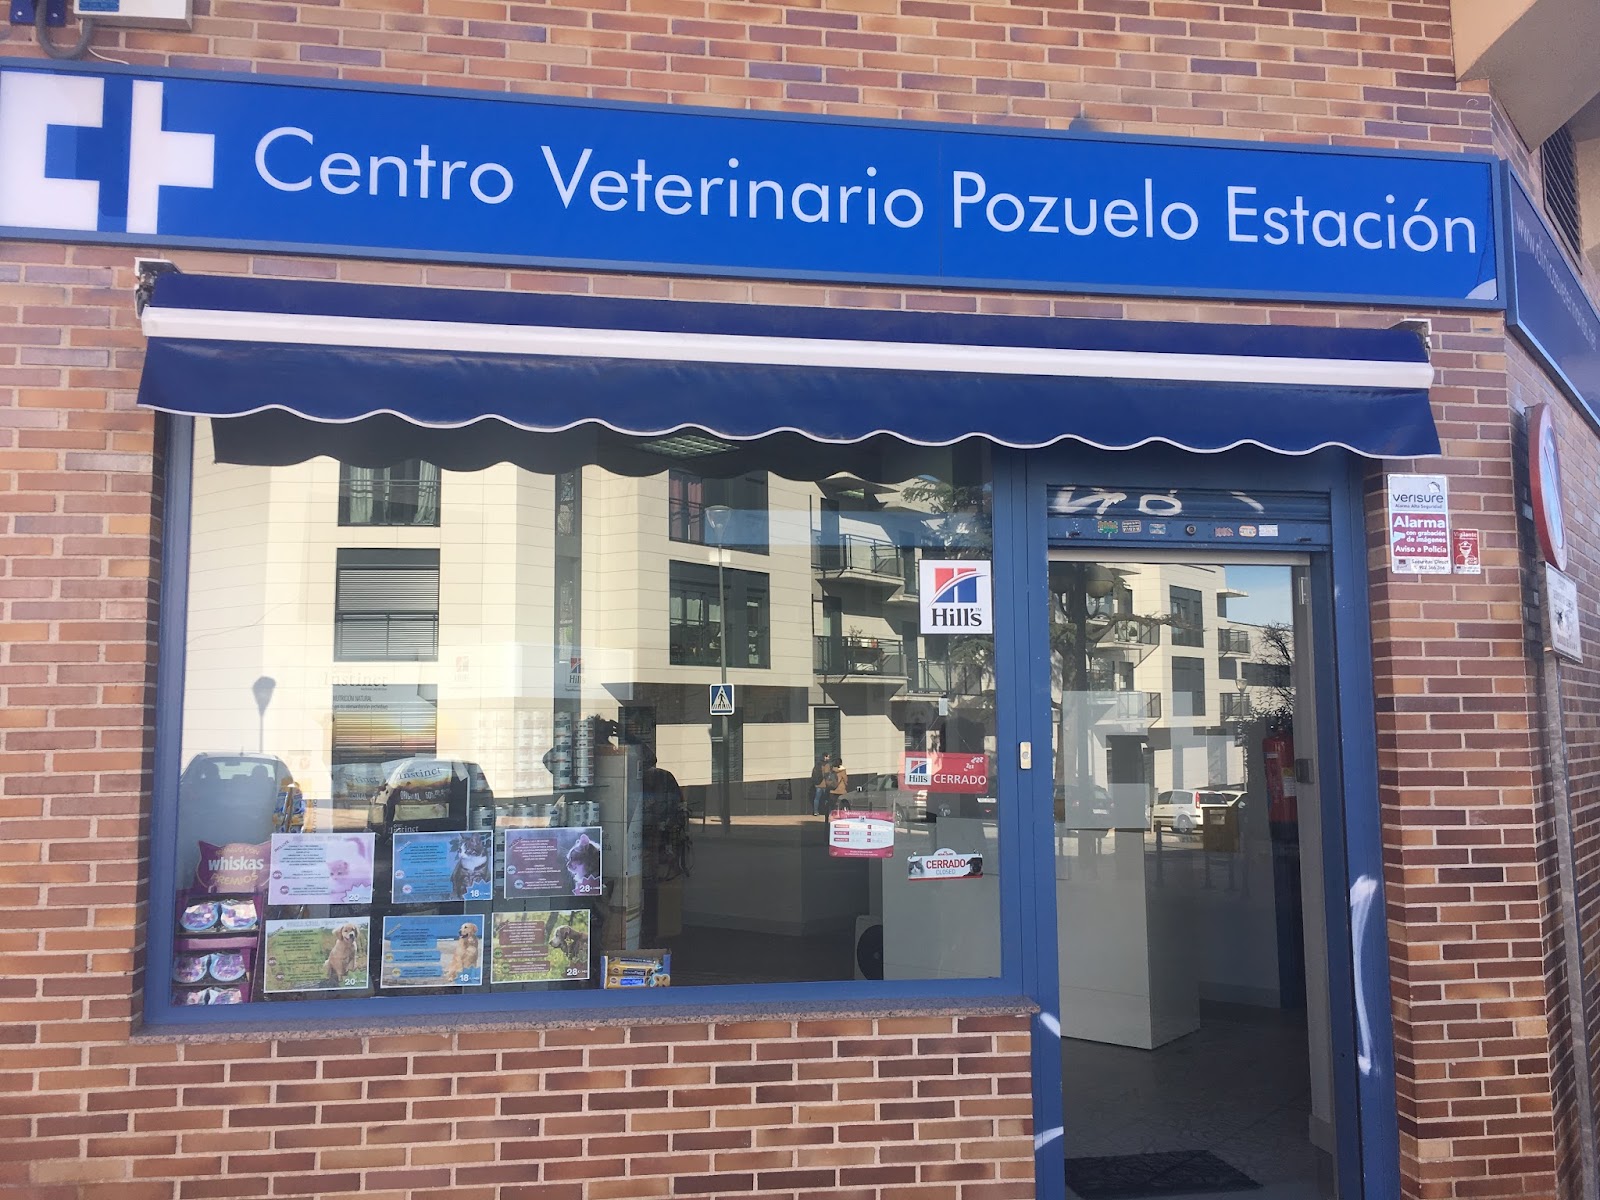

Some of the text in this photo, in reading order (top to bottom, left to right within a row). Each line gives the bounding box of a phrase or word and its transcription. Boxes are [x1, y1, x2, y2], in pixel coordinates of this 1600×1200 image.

[254, 126, 1478, 254] Centro Veterinario Pozuelo Estación
[1392, 493, 1444, 503] verisure
[1393, 516, 1445, 528] Alarma
[1417, 530, 1446, 538] grabación
[1416, 536, 1446, 544] imágenes
[1395, 545, 1415, 553] Aviso
[1423, 545, 1447, 553] Policía
[931, 607, 984, 628] Hill's
[399, 766, 441, 780] Instinct
[933, 773, 987, 786] CERRADO
[208, 855, 265, 872] whiskas
[926, 858, 966, 870] CERRADO
[935, 868, 956, 876] CLOSED
[211, 872, 259, 886] PREMIOS
[469, 889, 480, 898] 18
[579, 884, 591, 893] 28
[566, 967, 578, 977] 28
[344, 978, 356, 987] 20
[459, 973, 470, 982] 18
